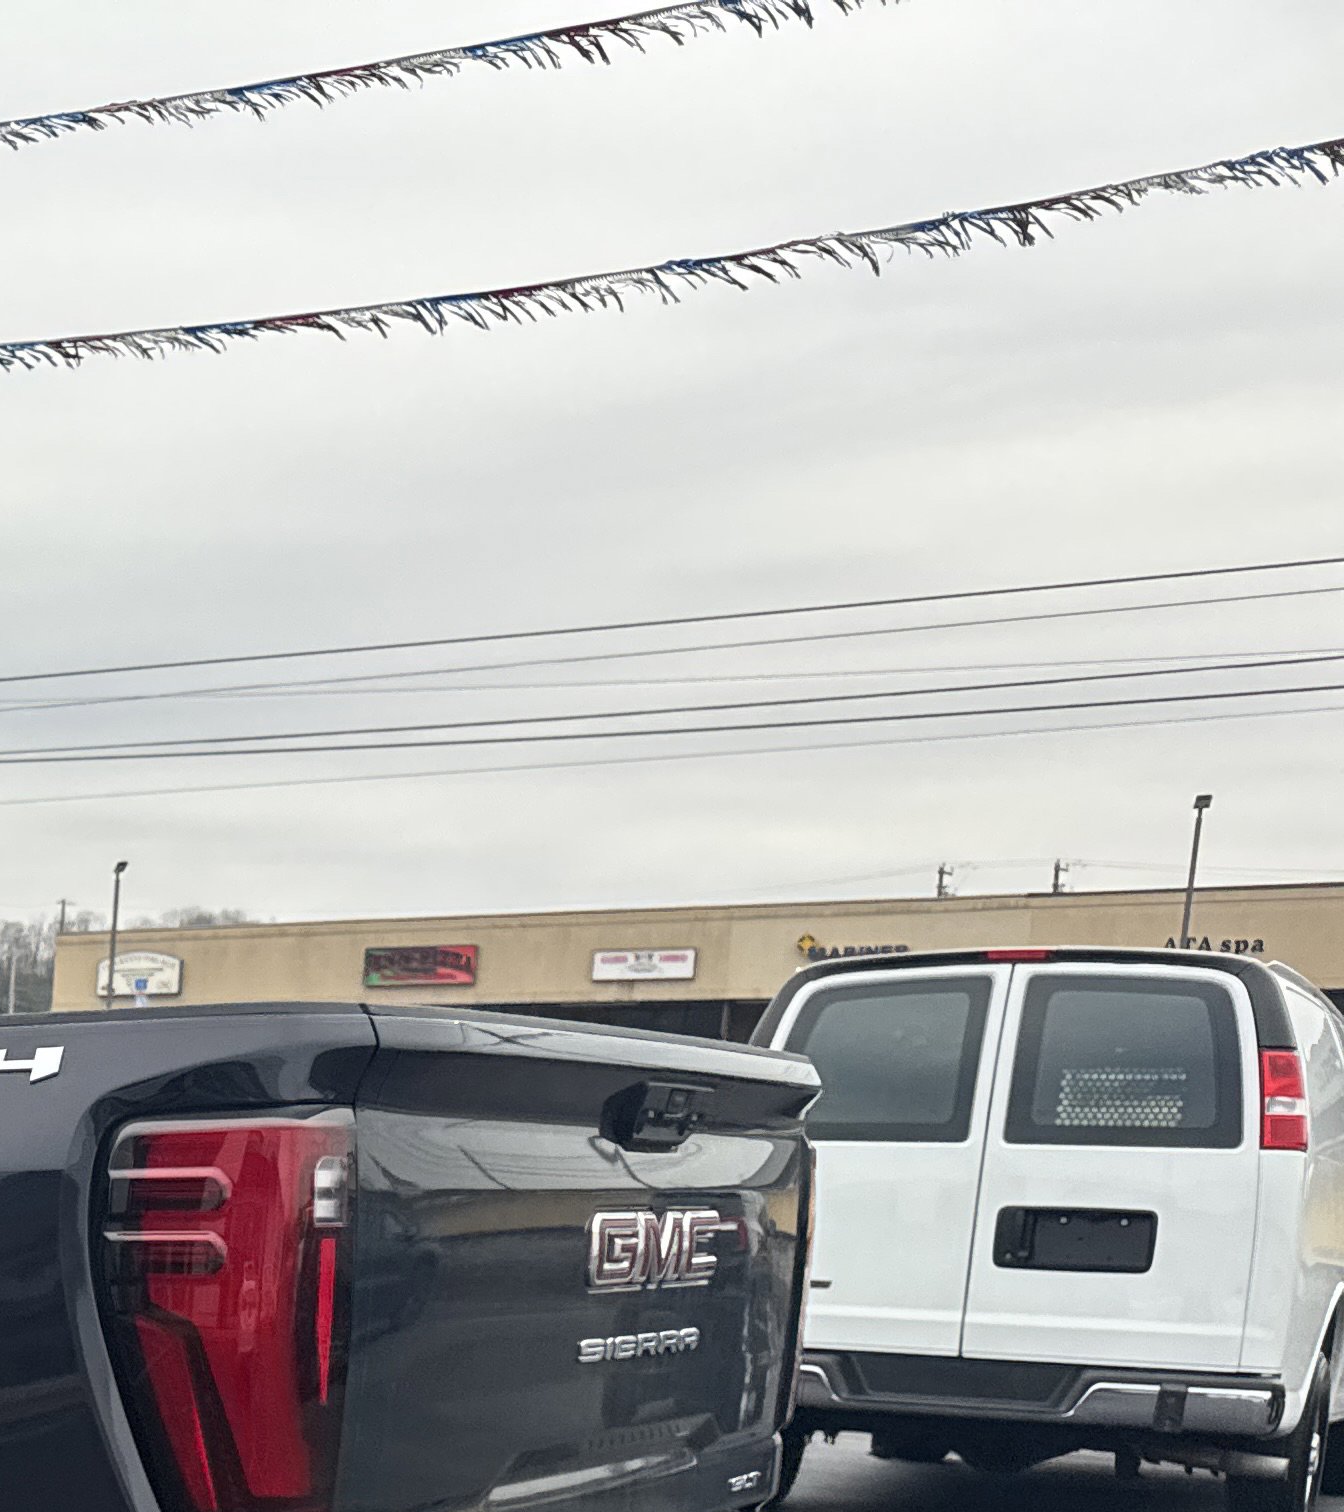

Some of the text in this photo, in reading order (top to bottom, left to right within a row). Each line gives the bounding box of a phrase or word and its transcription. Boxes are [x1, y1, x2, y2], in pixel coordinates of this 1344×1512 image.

[1220, 938, 1264, 954] spa
[589, 1209, 721, 1287] GMC
[578, 1326, 701, 1363] SIERRA
